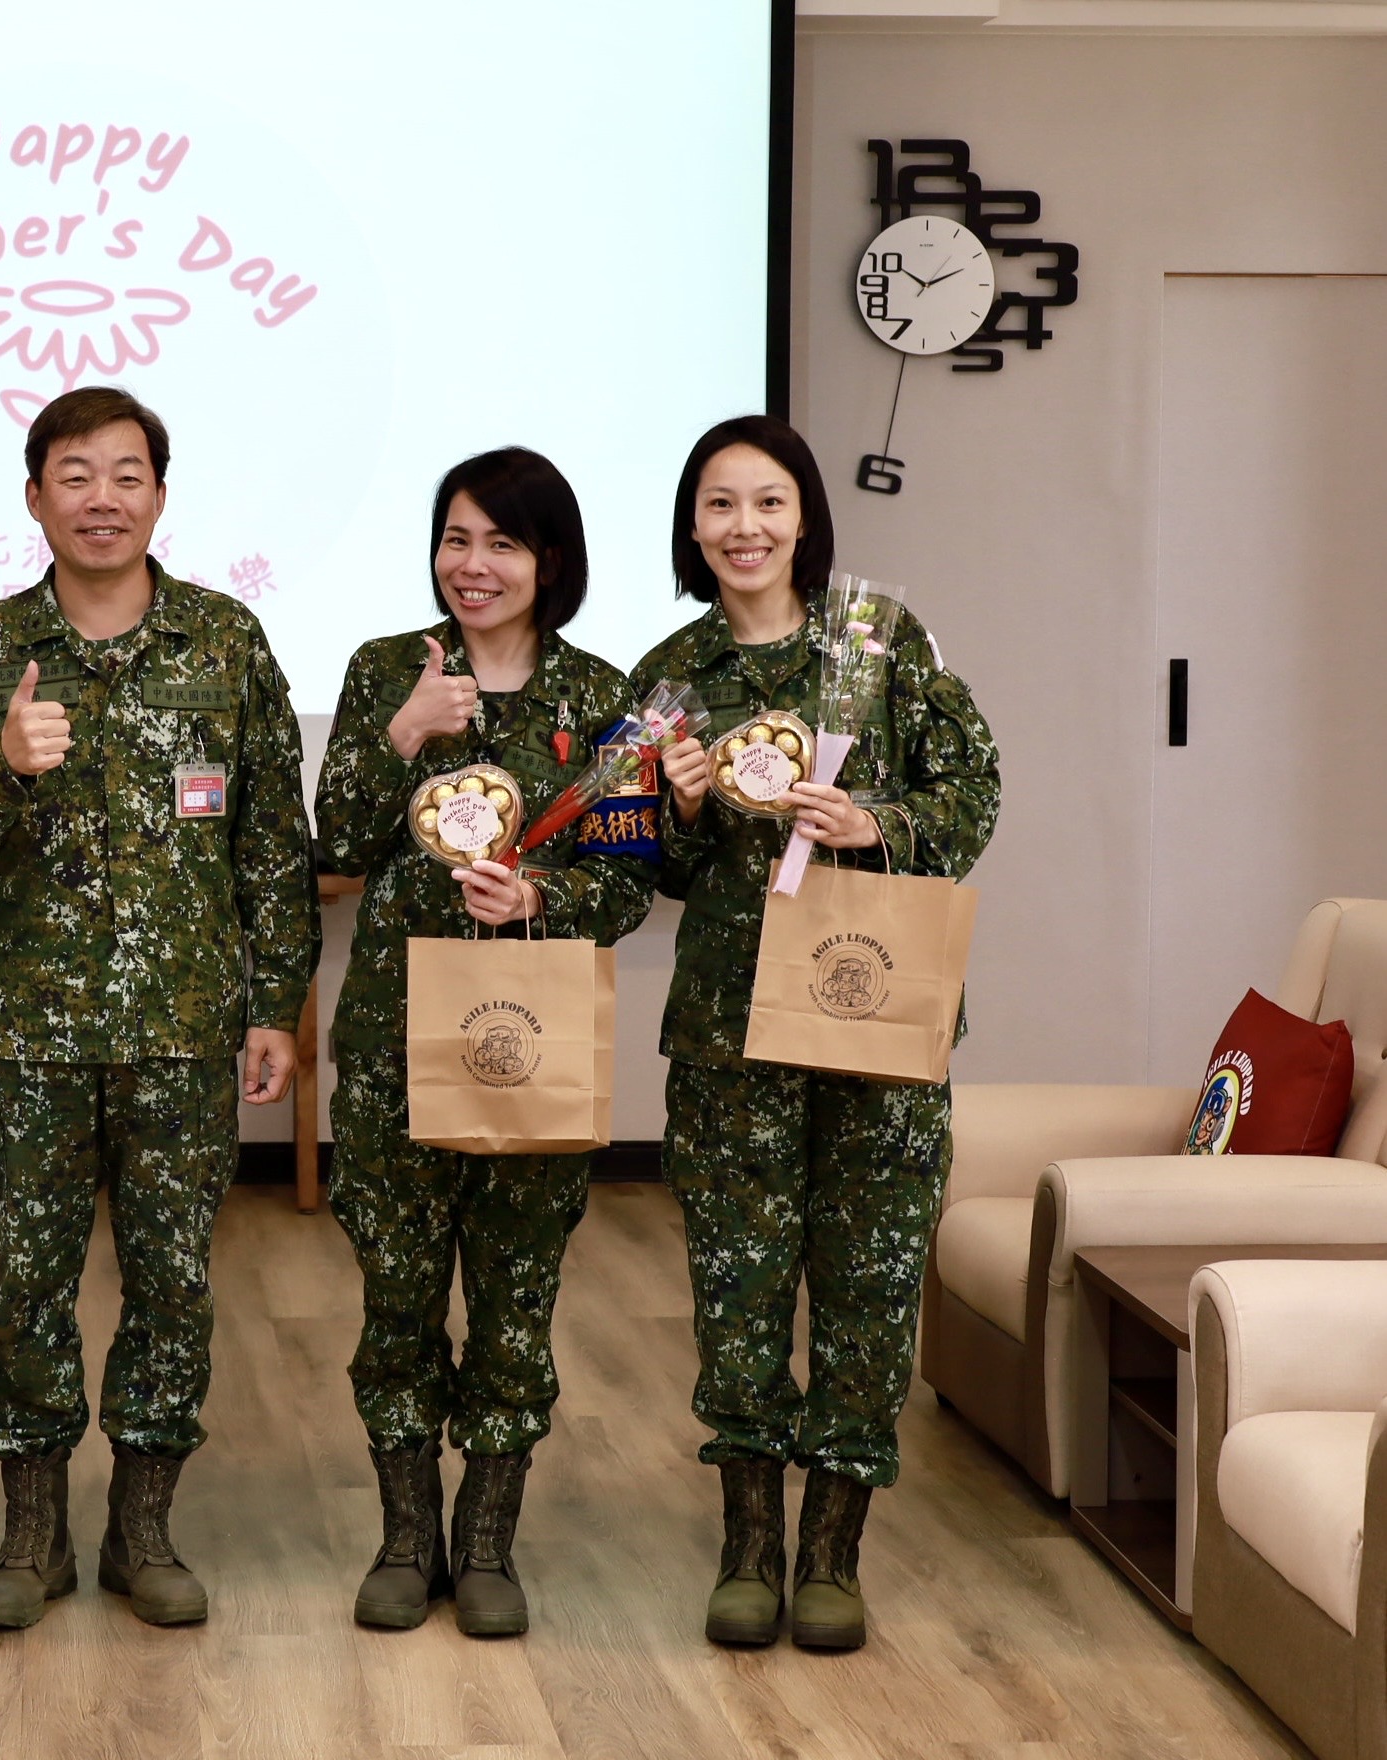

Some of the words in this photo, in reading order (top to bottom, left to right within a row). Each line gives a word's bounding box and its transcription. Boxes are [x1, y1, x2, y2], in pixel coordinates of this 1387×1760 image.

[178, 215, 318, 328] Day
[868, 252, 902, 273] 10
[860, 275, 889, 294] 9
[867, 293, 888, 319] 8
[881, 318, 913, 340] 7
[856, 454, 905, 495] 6
[153, 686, 223, 703] 中華民國陸軍
[741, 747, 761, 760] Happy
[764, 753, 778, 761] Day
[448, 797, 471, 808] Happy
[472, 803, 487, 812] Day
[811, 934, 844, 963] AGILE
[846, 933, 894, 971] LEOPARD
[808, 983, 819, 1004] North
[849, 1008, 877, 1021] Training
[875, 989, 890, 1010] Center
[459, 1002, 491, 1034] AGILE
[493, 1000, 543, 1035] LEOPARD
[460, 1054, 473, 1074] North
[472, 1071, 504, 1089] Combined
[504, 1073, 531, 1089] Training
[528, 1052, 542, 1075] Center
[1232, 1050, 1254, 1116] LEOPARD
